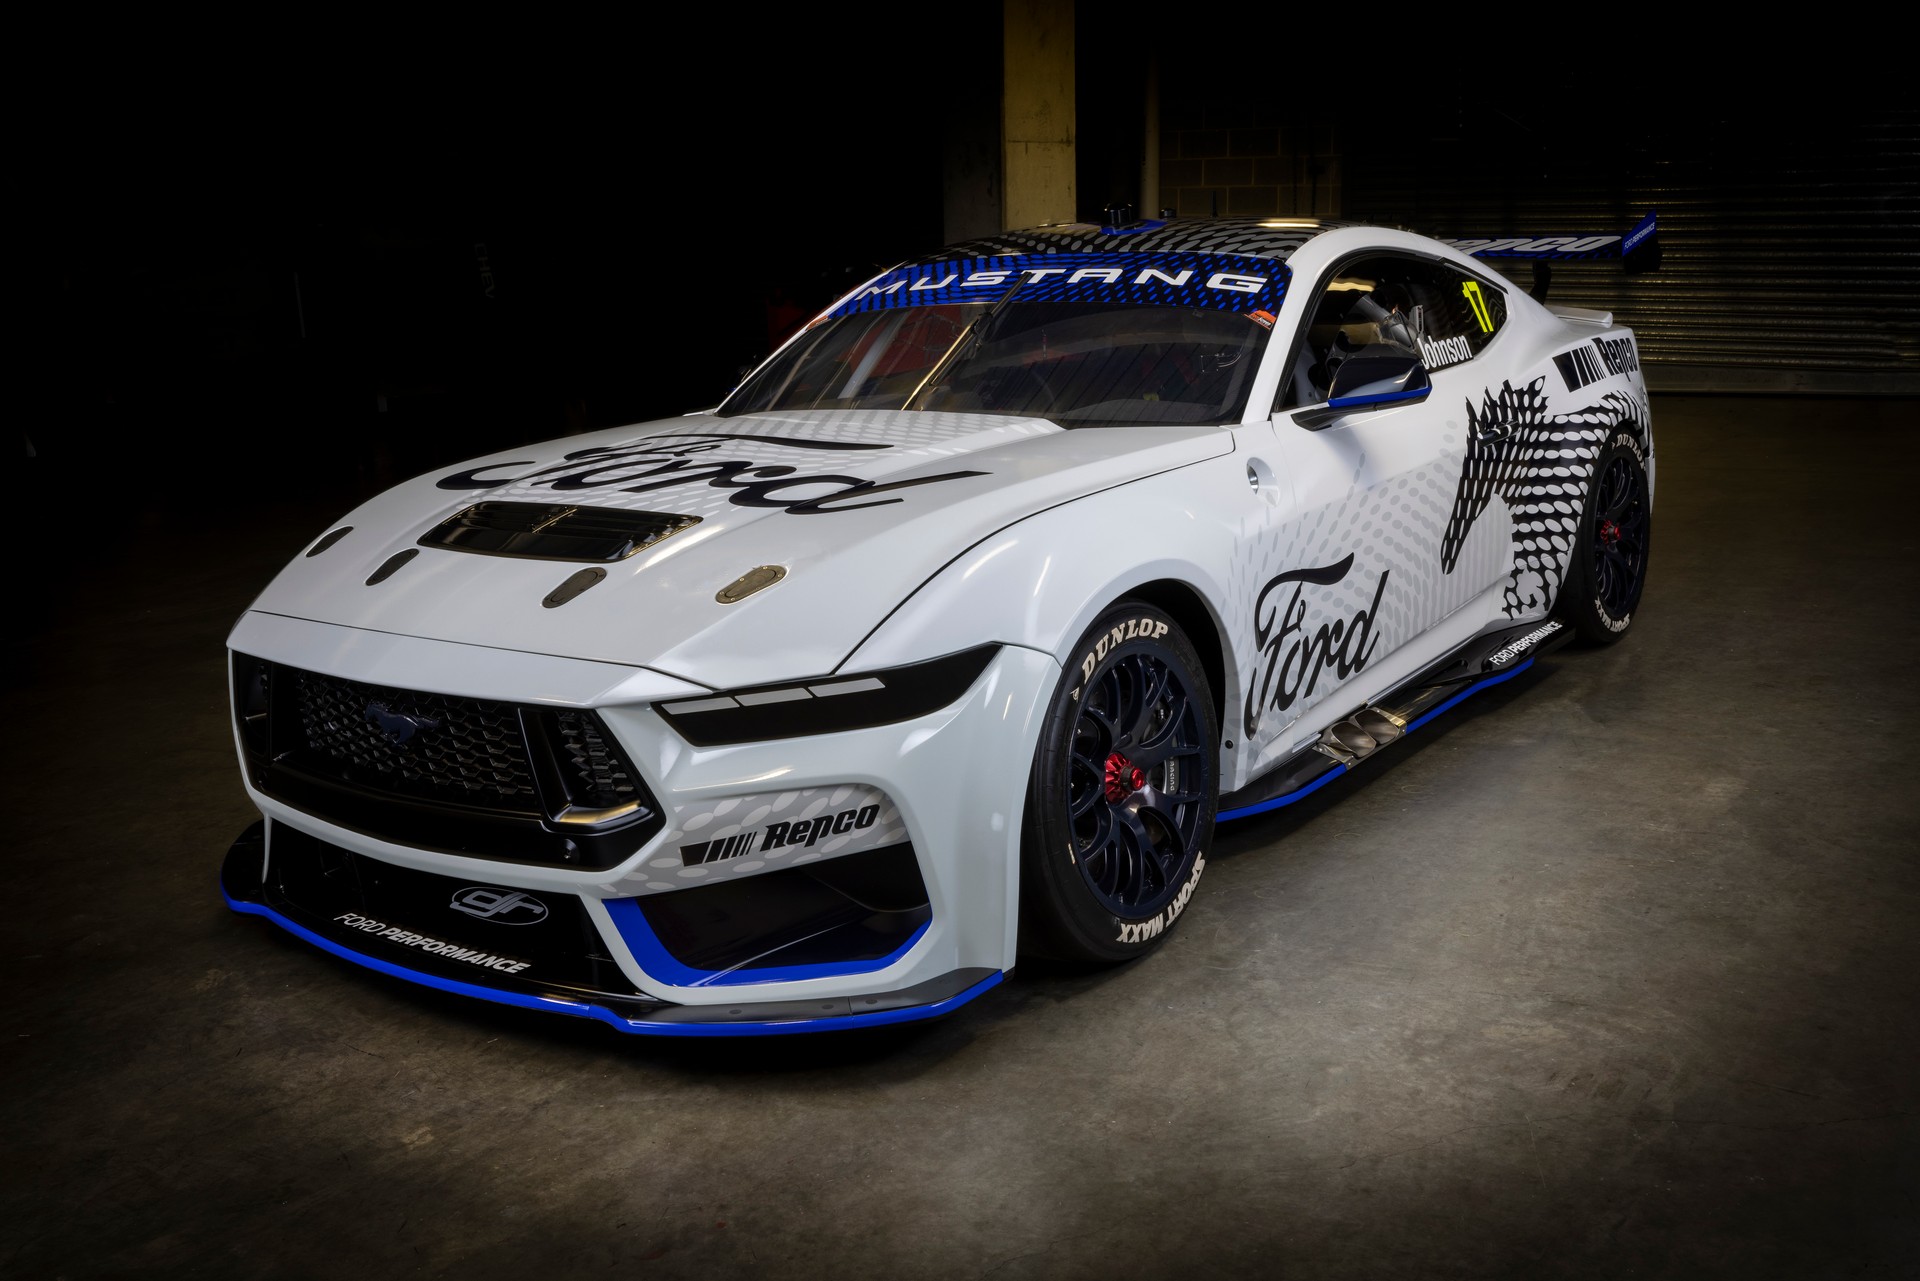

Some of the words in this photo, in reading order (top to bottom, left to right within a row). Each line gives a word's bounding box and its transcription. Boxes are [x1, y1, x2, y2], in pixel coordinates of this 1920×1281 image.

[854, 268, 1269, 301] MUSTANG
[1462, 281, 1494, 333] 17
[1417, 335, 1473, 370] Johnson
[1591, 337, 1638, 382] Repco
[436, 433, 993, 515] Ford
[1081, 618, 1168, 685] DUNLOP
[1244, 552, 1390, 741] Ford
[1489, 649, 1515, 666] FORD
[1507, 621, 1563, 654] PERFORMANCE
[760, 804, 880, 852] Repco
[1165, 850, 1206, 928] SPORT
[333, 912, 387, 934] FORD
[376, 926, 532, 974] PERFORMANCE
[1116, 912, 1164, 943] MAXX
